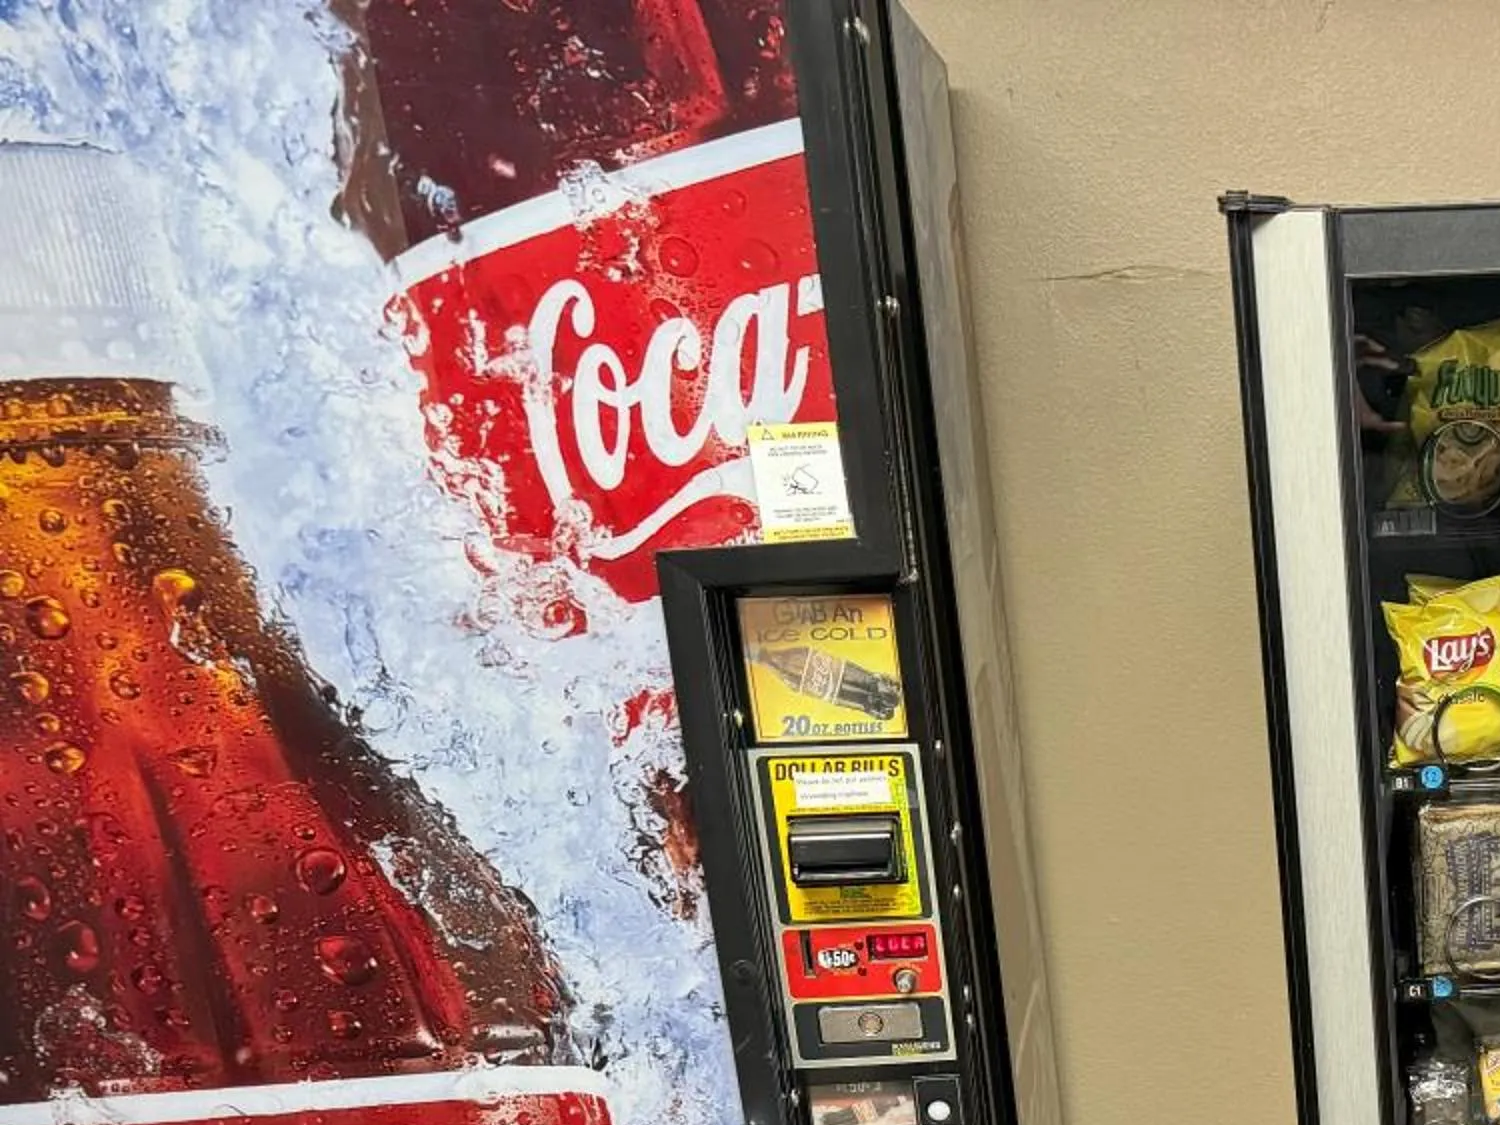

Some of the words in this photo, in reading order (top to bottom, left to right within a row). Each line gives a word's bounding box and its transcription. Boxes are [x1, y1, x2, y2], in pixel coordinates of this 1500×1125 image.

[810, 626, 887, 641] COLD
[1424, 627, 1492, 673] Lay's
[782, 715, 811, 736] 20
